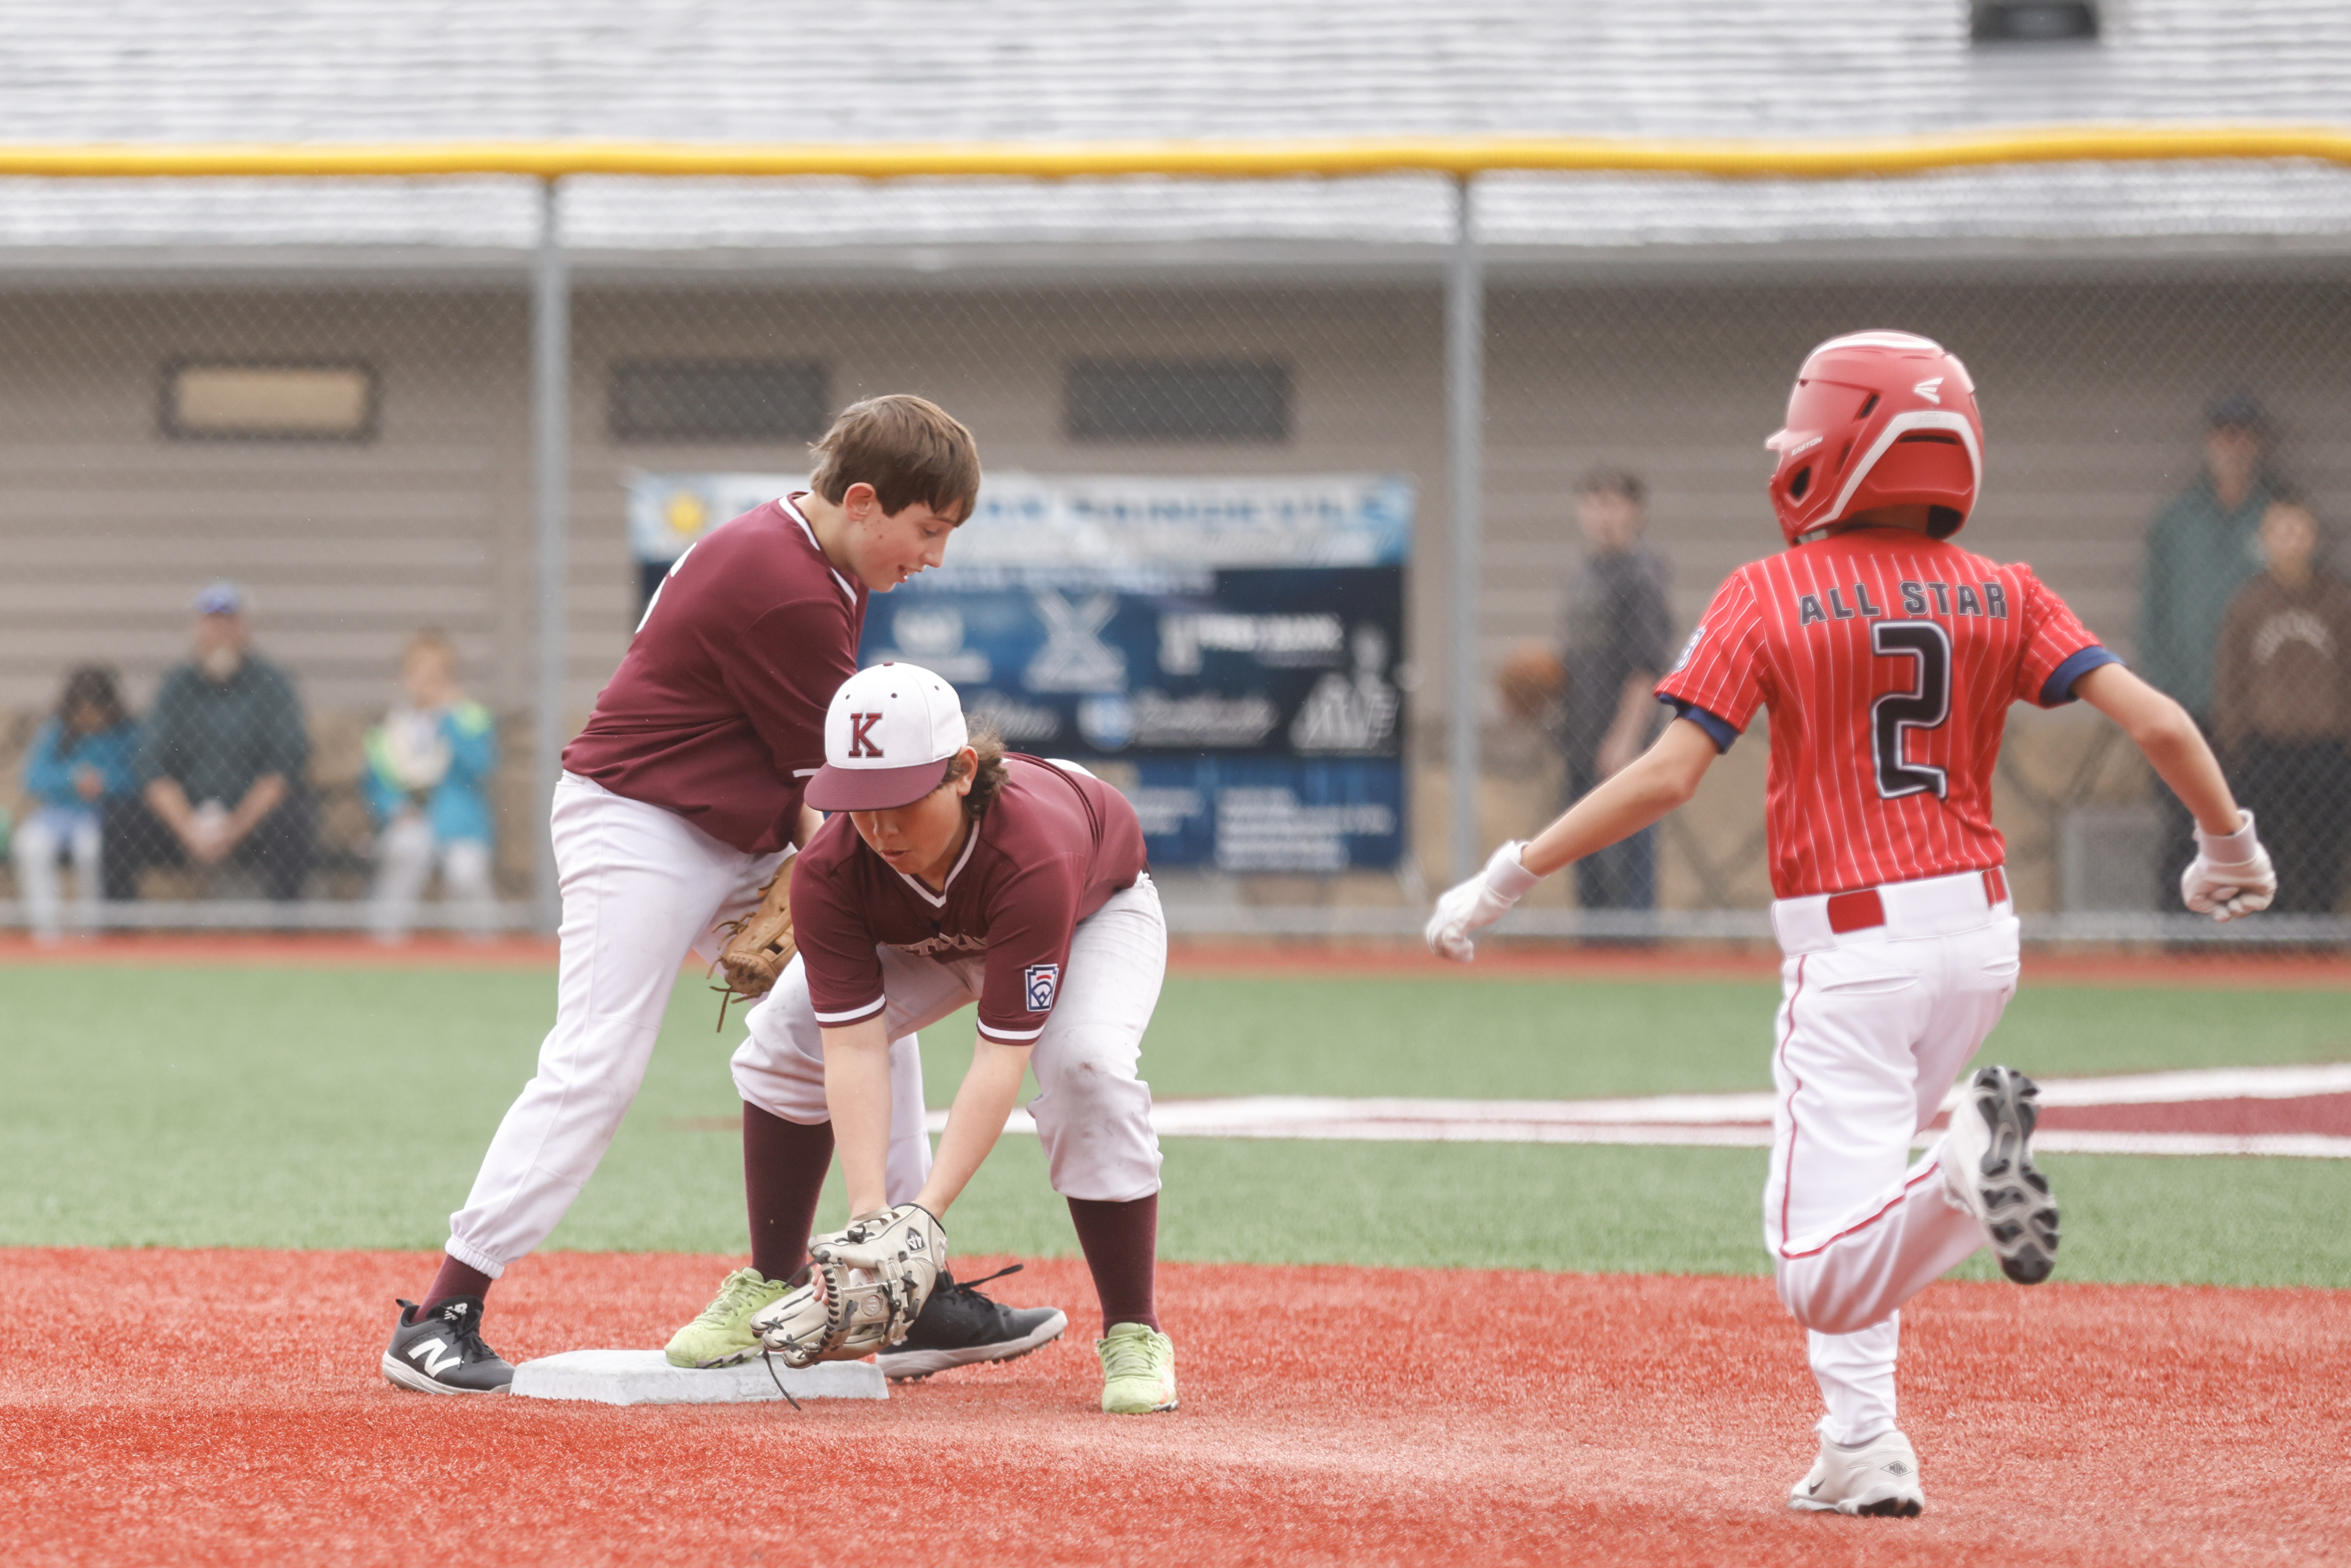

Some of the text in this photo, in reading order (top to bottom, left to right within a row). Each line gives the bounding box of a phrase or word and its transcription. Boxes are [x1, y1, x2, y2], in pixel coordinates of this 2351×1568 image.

[1791, 436, 1823, 456] EASTON
[1800, 581, 2008, 627] ALL STAR
[1871, 620, 1951, 800] 2
[848, 710, 885, 759] K
[1889, 1462, 1908, 1475] NIKE
